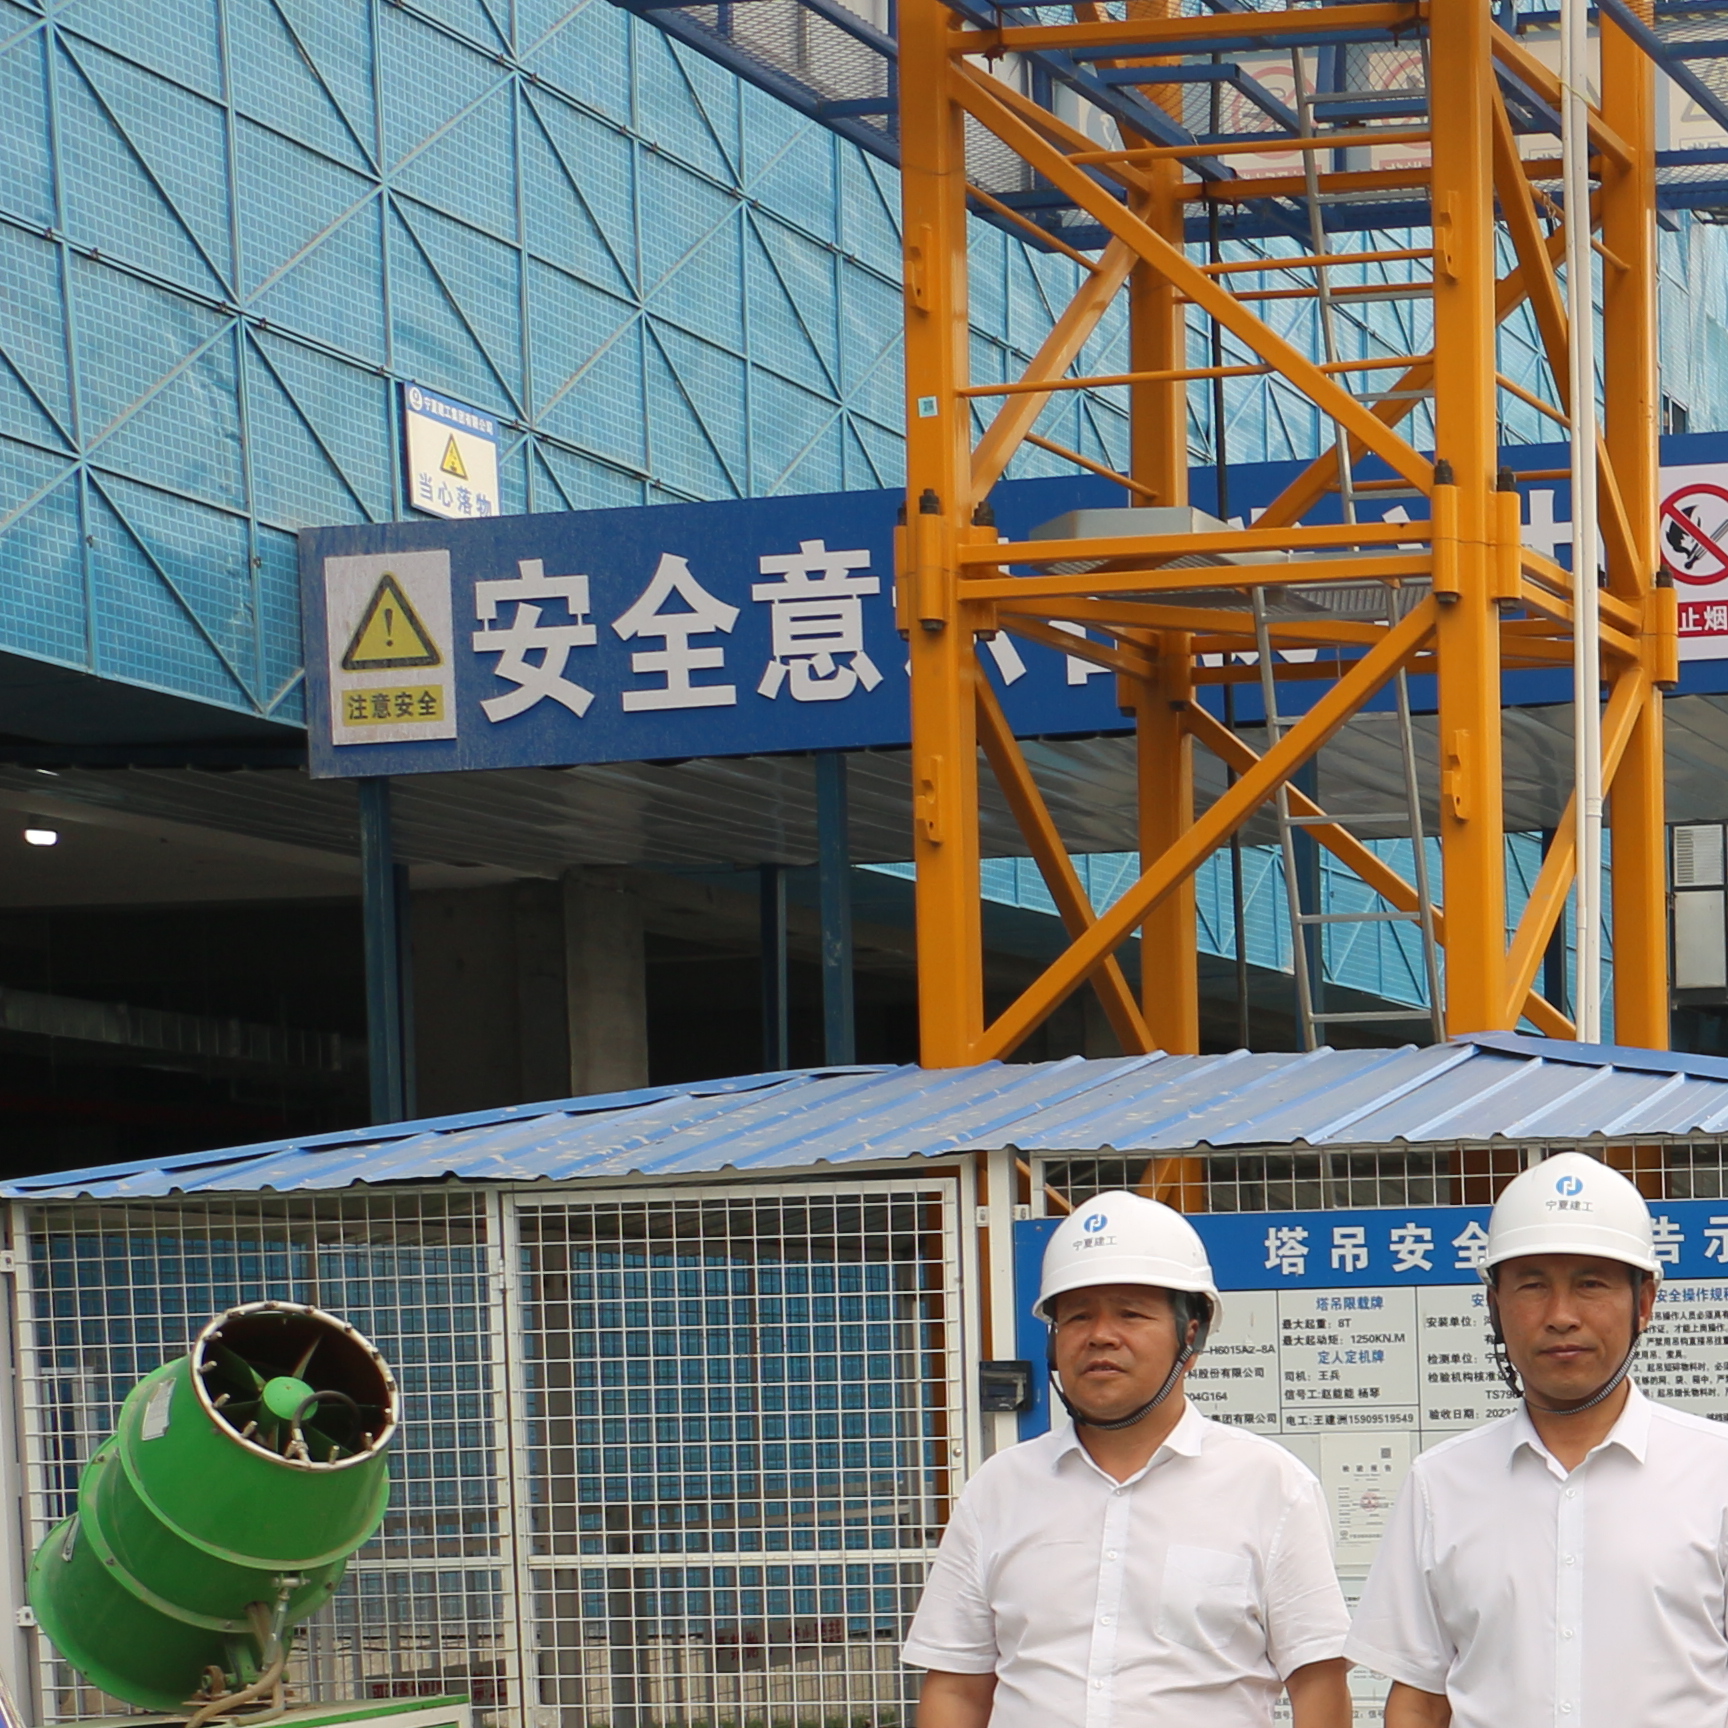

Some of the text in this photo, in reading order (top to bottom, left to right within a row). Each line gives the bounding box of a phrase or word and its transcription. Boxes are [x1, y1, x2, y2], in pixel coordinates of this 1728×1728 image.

[419, 472, 492, 517] 当心落物
[348, 689, 438, 722] 注意安全
[1545, 1200, 1594, 1212] 宁夏建工
[1072, 1236, 1118, 1252] 宁夏建工
[1316, 1296, 1384, 1312] 塔吊限载牌
[1318, 1350, 1385, 1365] 定人定机牌
[1204, 1412, 1278, 1425] 集团有限公司
